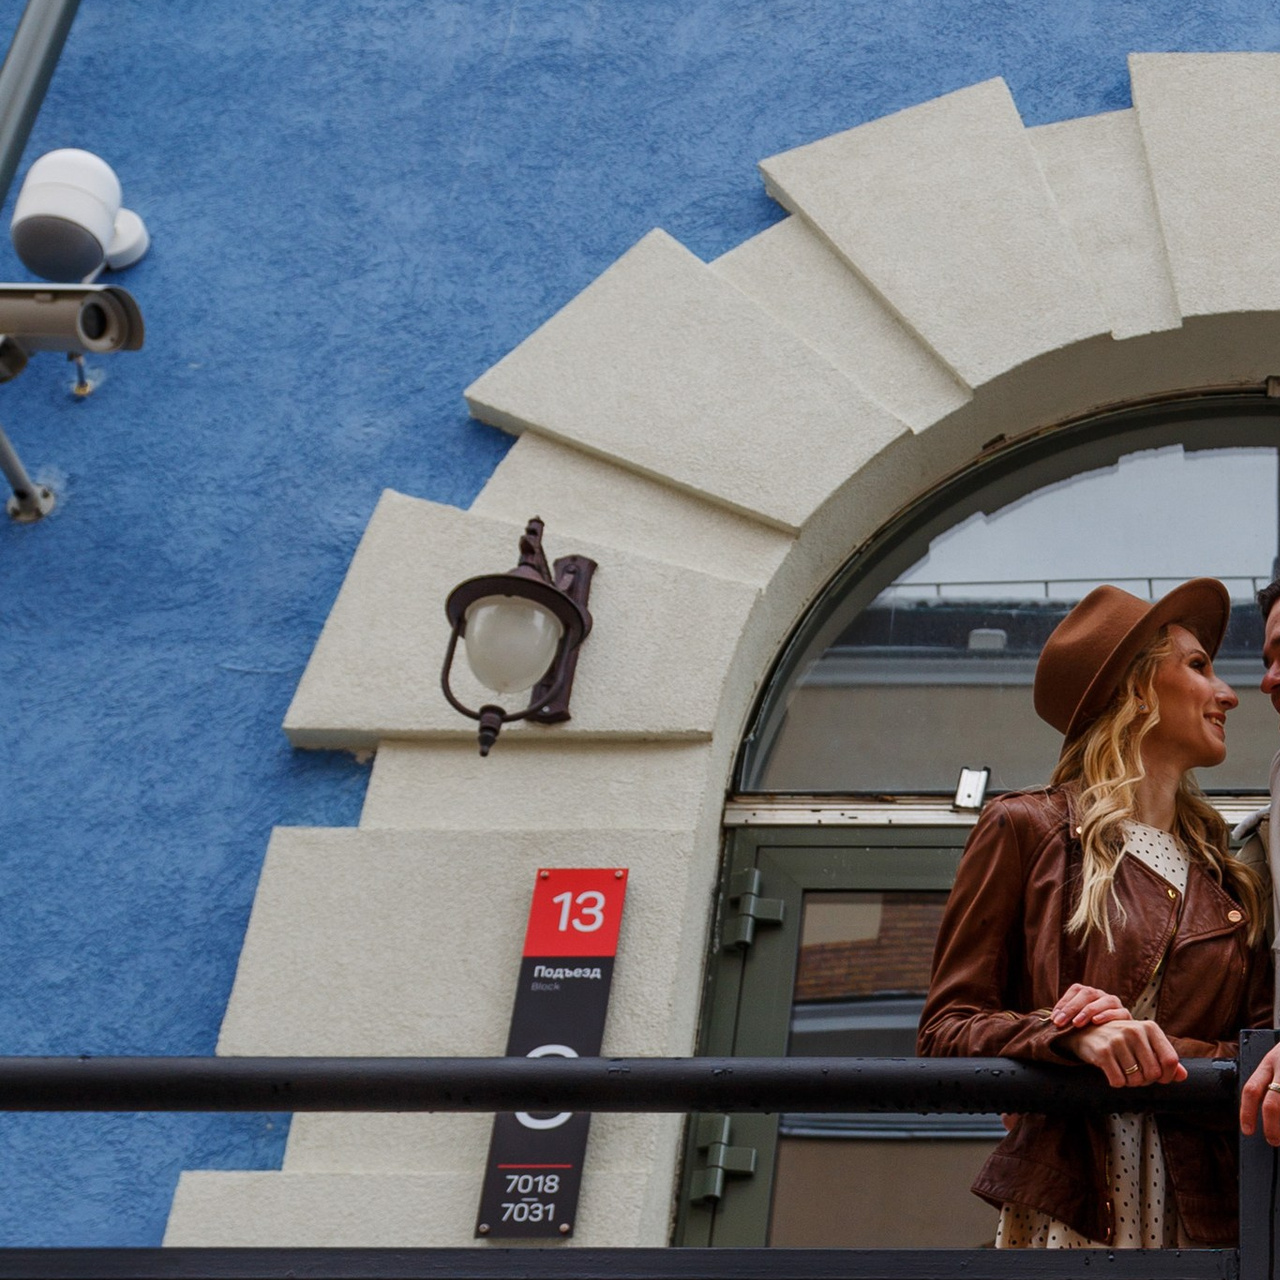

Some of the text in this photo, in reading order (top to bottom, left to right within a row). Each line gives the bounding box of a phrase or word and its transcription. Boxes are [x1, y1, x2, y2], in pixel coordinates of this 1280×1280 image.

[552, 890, 606, 933] 13
[533, 965, 602, 980] Подъезд
[530, 982, 561, 992] Block
[505, 1174, 560, 1194] 7018
[501, 1202, 556, 1222] 7031
